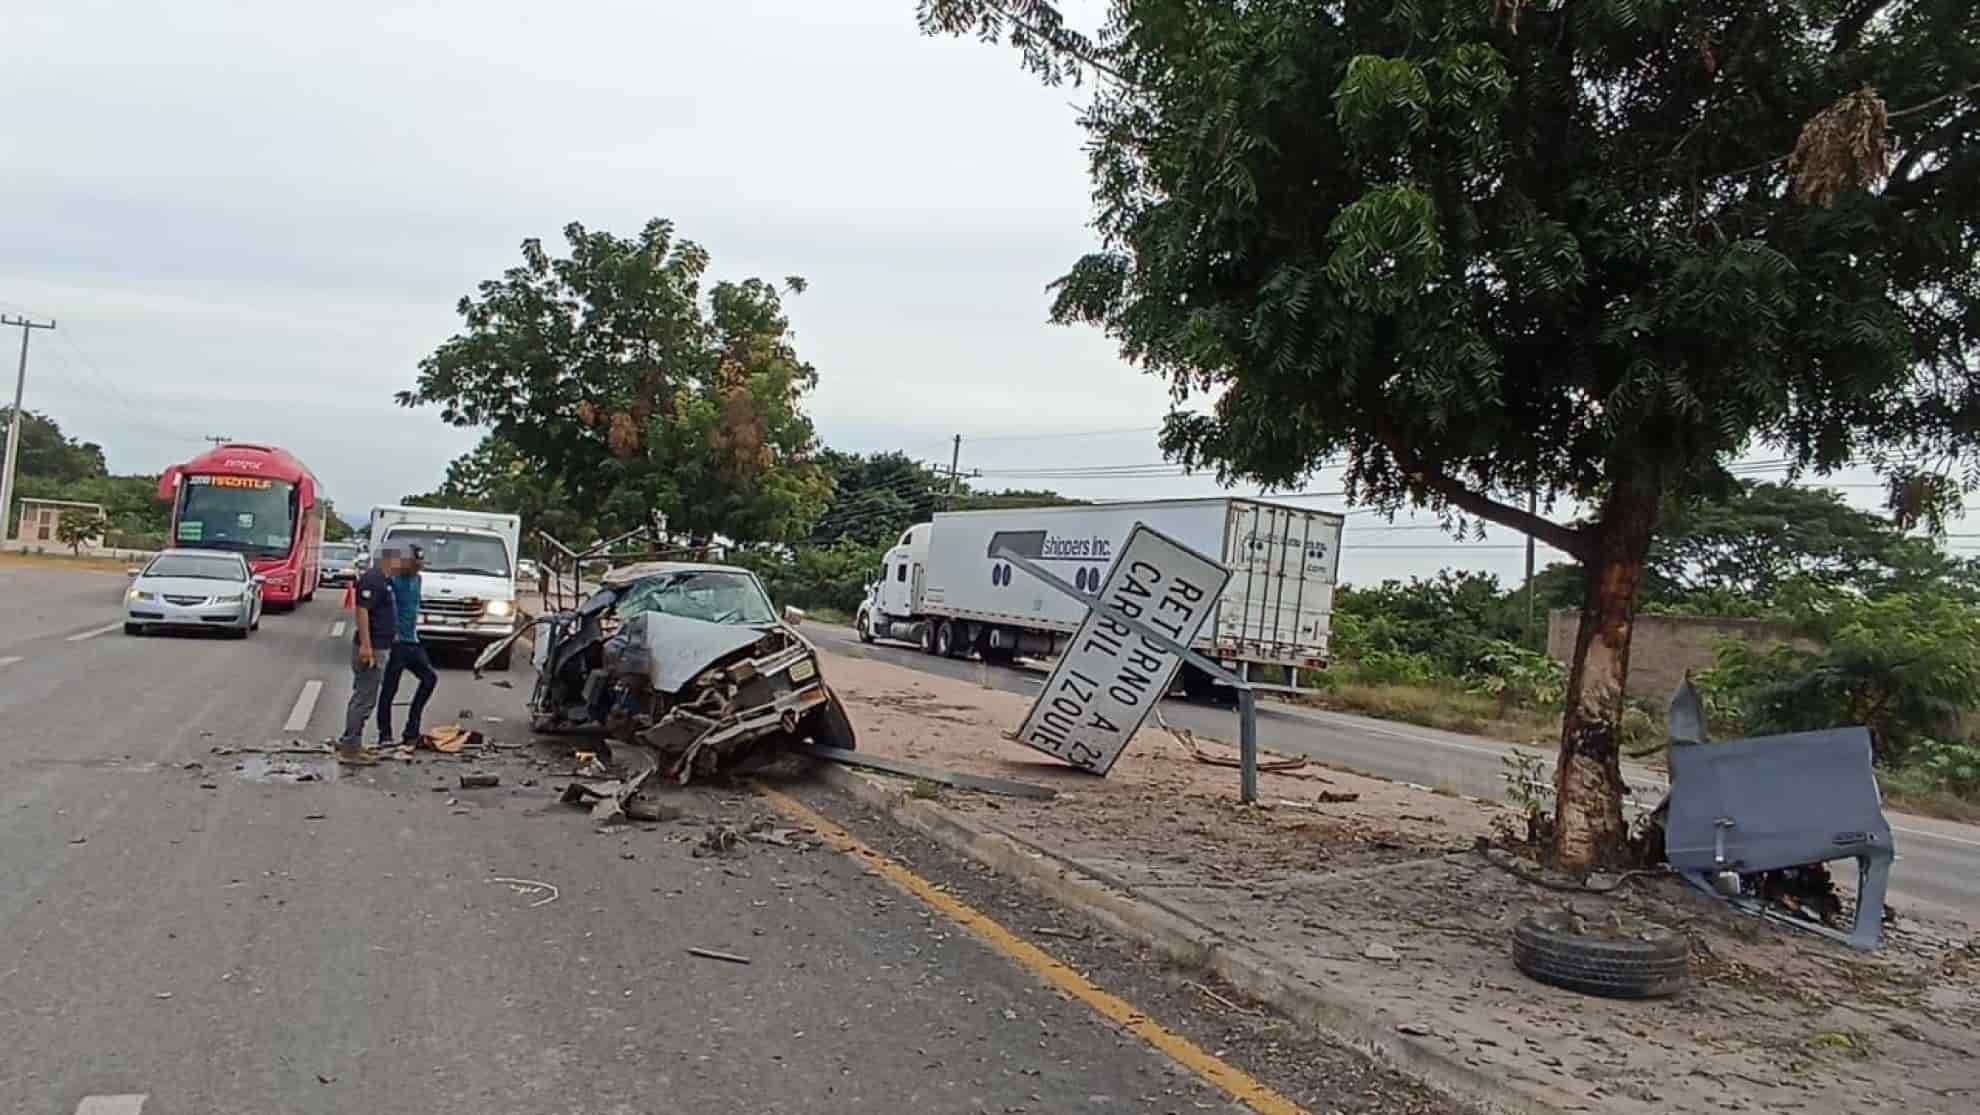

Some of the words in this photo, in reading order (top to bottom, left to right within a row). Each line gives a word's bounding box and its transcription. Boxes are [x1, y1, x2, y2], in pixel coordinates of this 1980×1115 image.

[1083, 561, 1161, 657] CARRIL
[1030, 669, 1099, 751] IZQUIE
[1087, 712, 1120, 733] A
